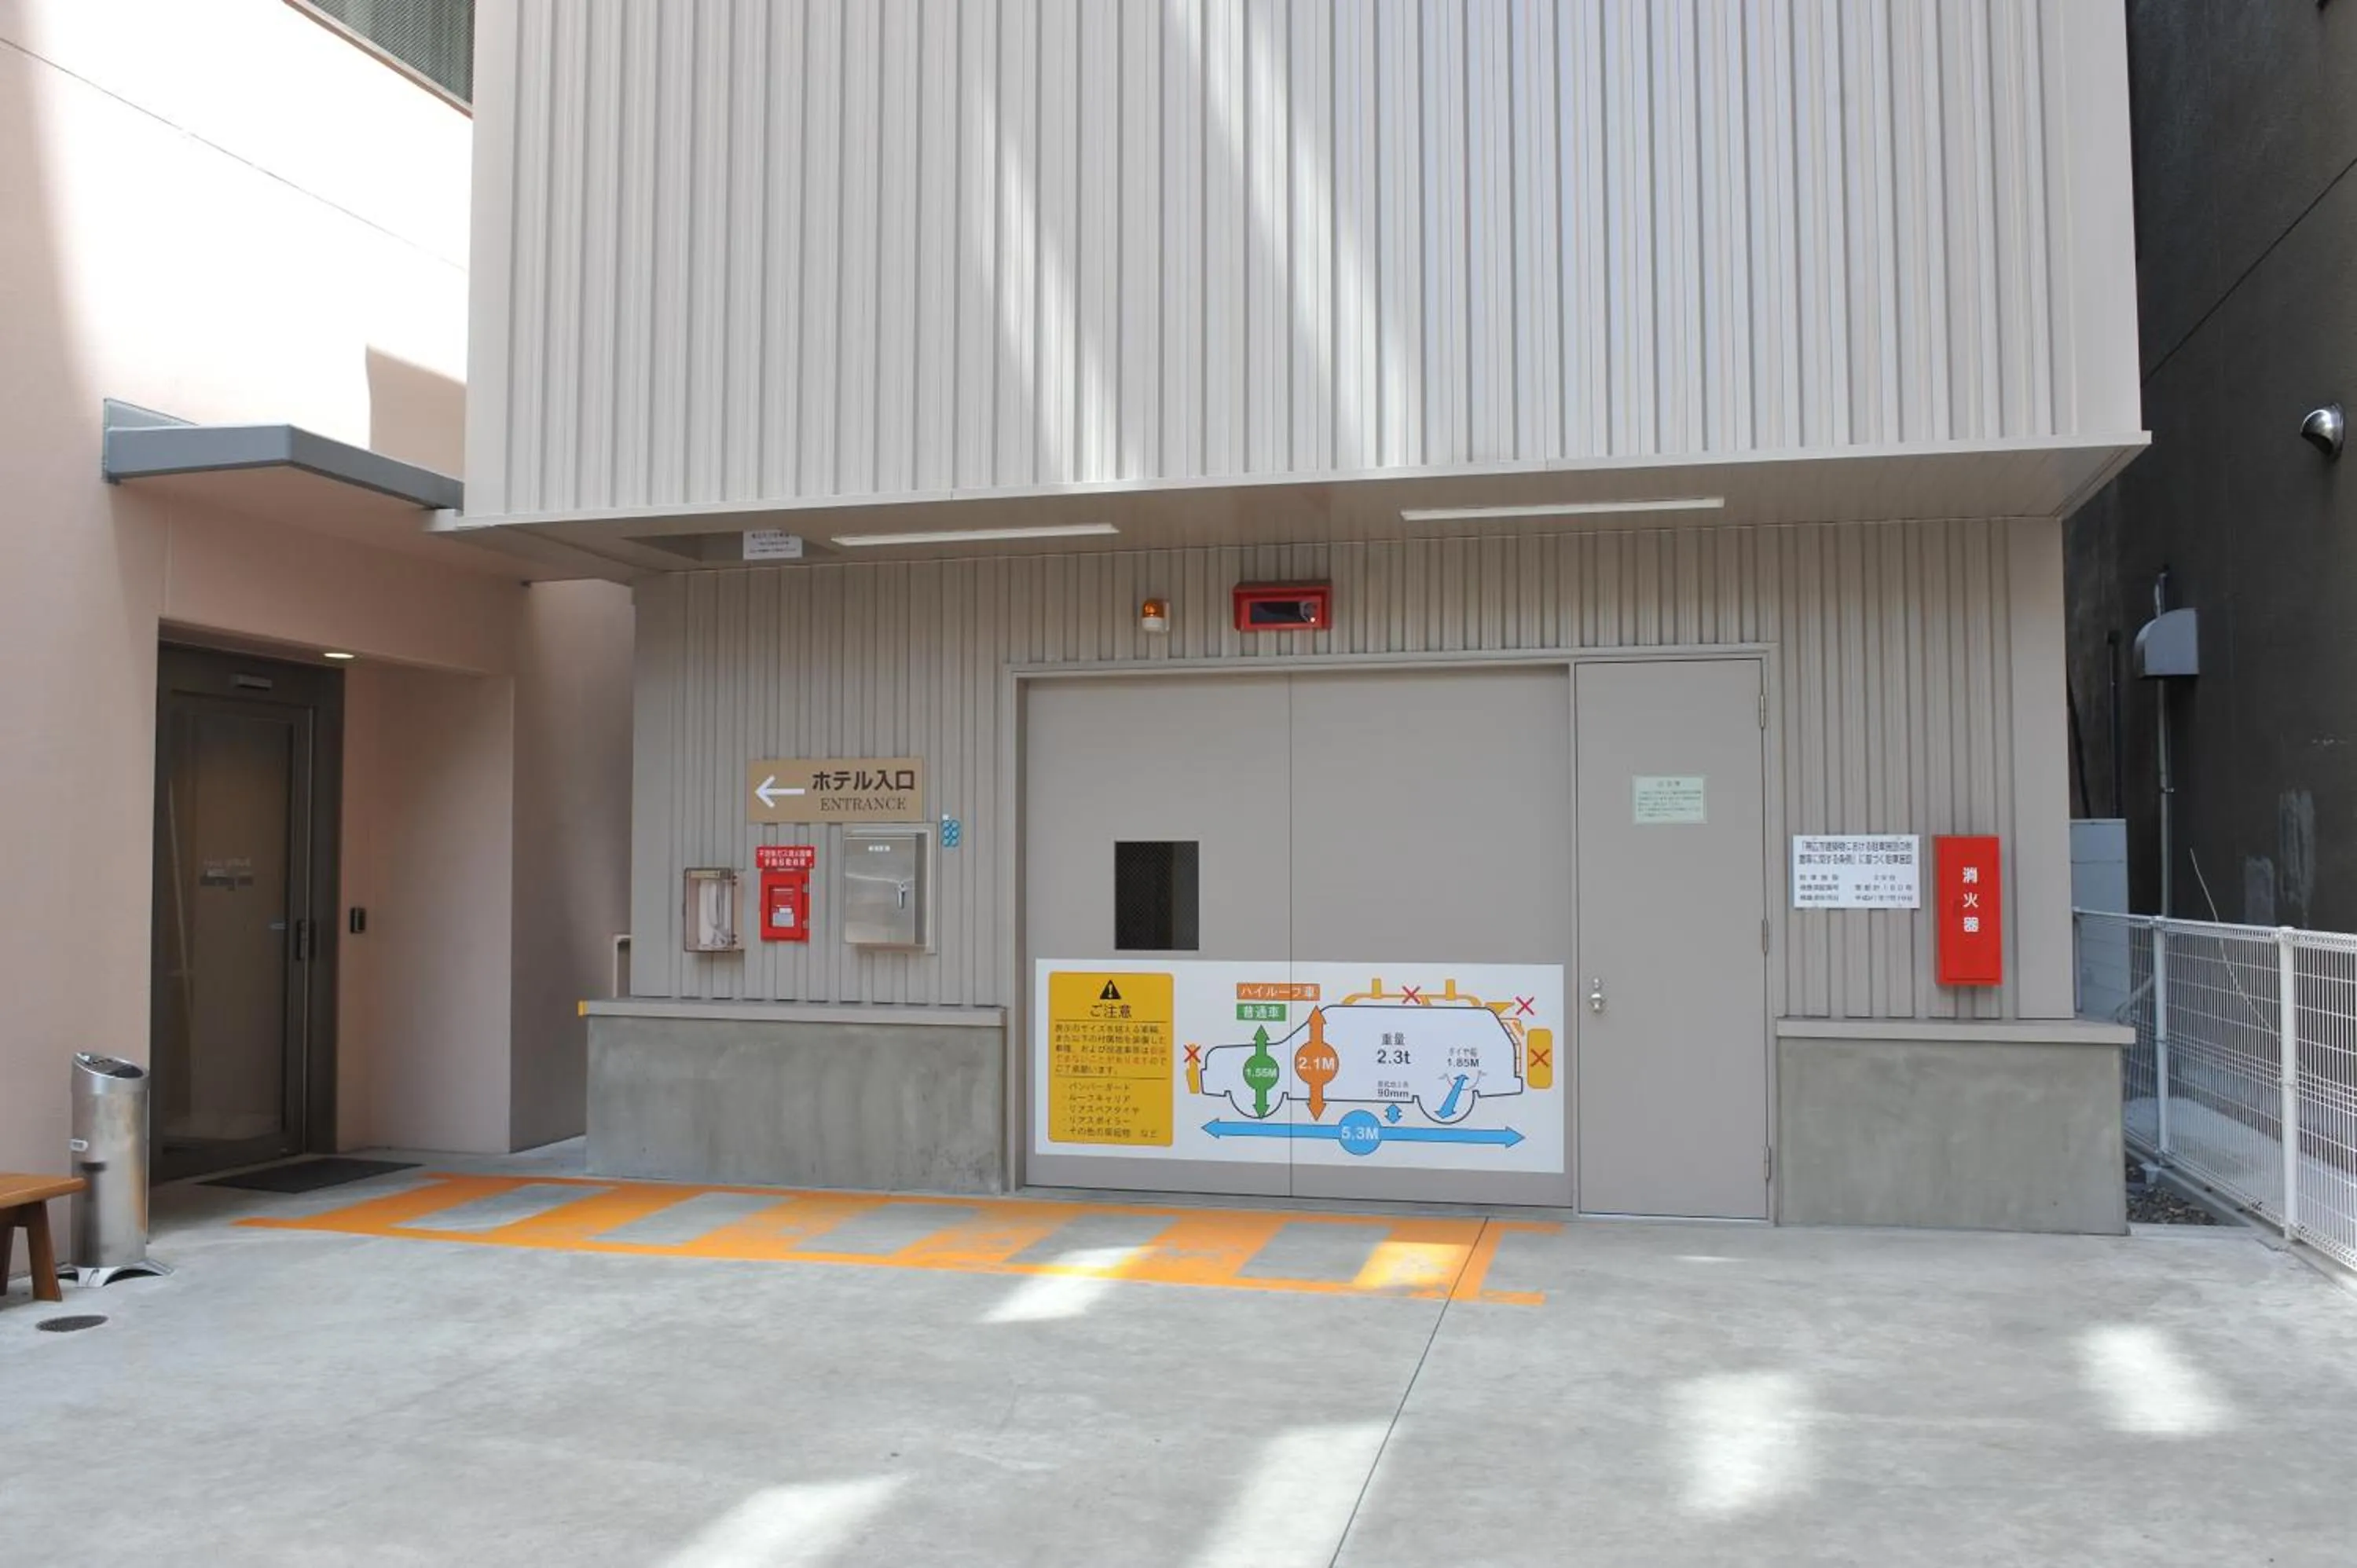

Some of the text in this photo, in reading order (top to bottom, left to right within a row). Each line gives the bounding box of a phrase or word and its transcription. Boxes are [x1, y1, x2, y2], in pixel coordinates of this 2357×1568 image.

[812, 769, 916, 792] ホテル入口
[819, 797, 907, 811] ENTRANCE
[1962, 866, 1980, 933] 消火器
[1241, 985, 1315, 998] ハイルーフ車
[1090, 1003, 1132, 1019] ご注意
[1244, 1005, 1280, 1020] 普通車
[1381, 1031, 1406, 1046] 重量
[1298, 1056, 1336, 1070] 2.1M
[1376, 1050, 1411, 1065] 2.3t
[1447, 1057, 1479, 1068] 1.85M
[1246, 1067, 1277, 1078] 1.55M
[1376, 1088, 1409, 1098] 90mm
[1340, 1126, 1380, 1141] 5.3M
